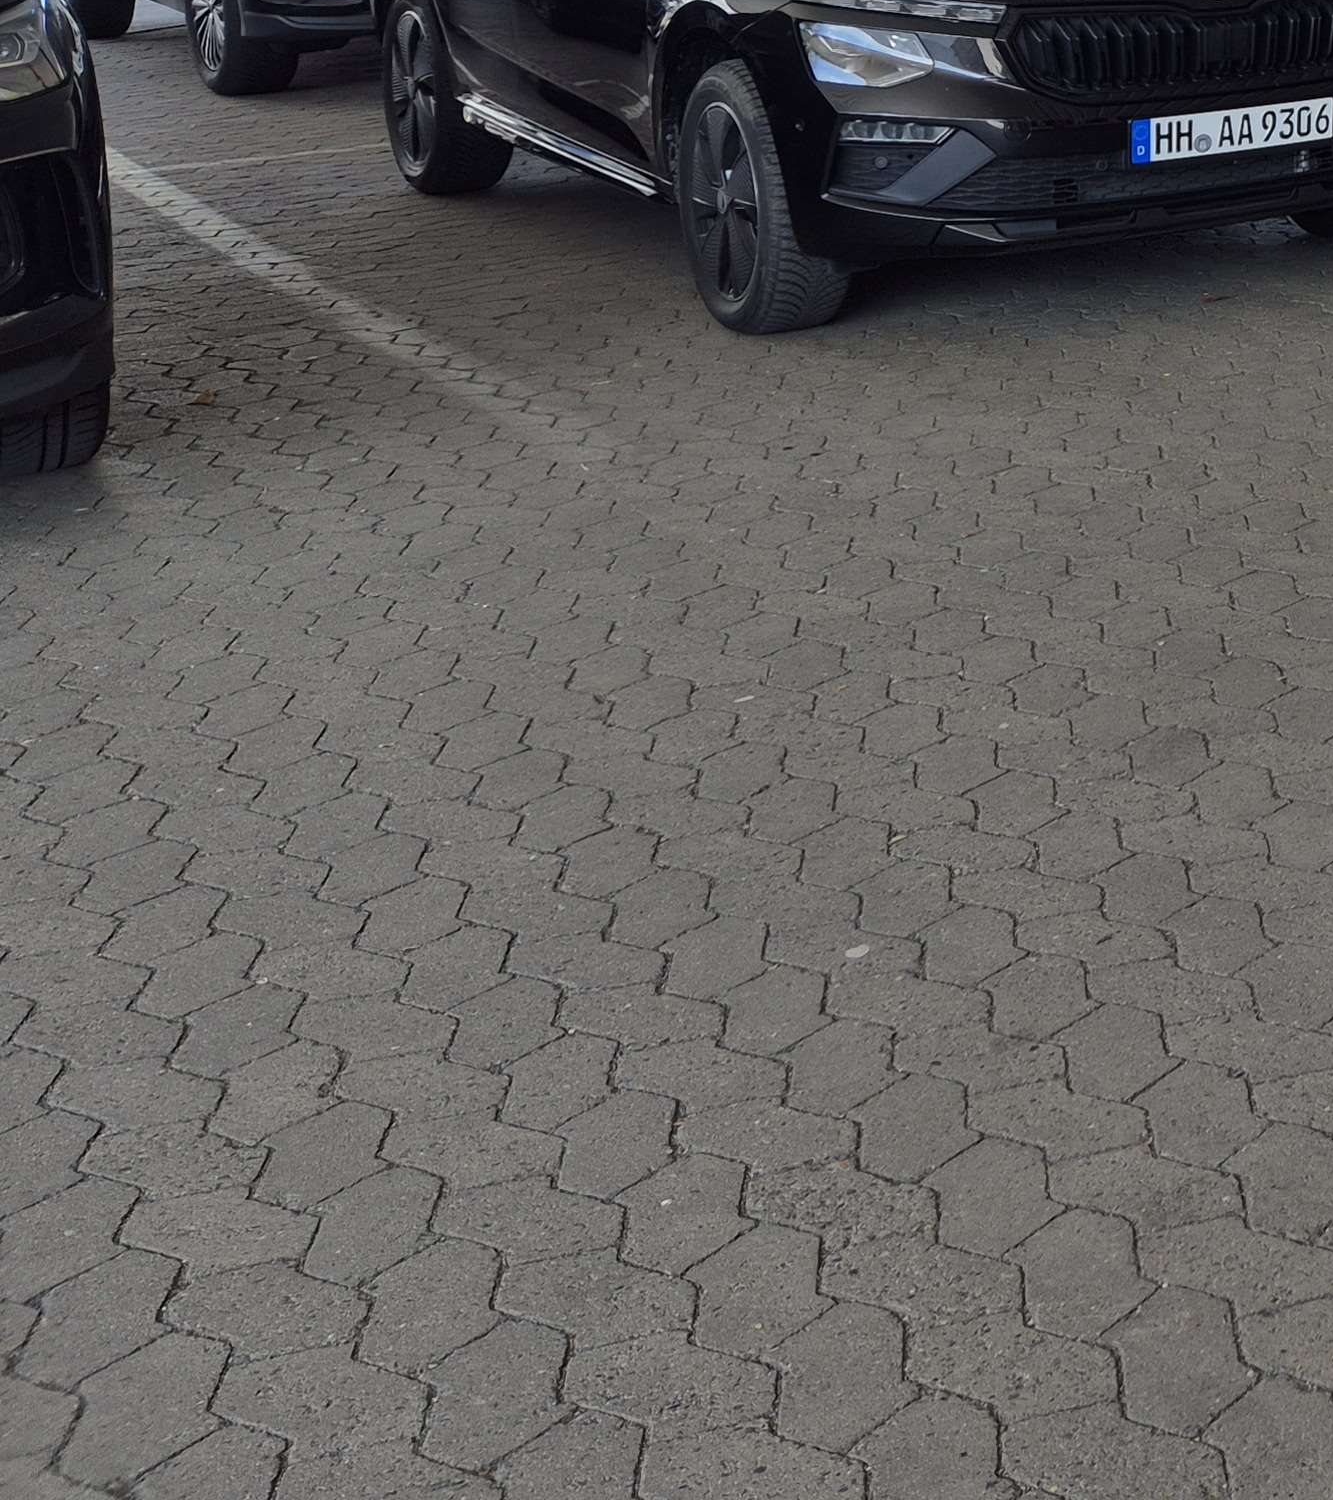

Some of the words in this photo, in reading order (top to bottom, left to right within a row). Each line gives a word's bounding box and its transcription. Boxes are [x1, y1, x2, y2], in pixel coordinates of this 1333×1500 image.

[1155, 119, 1193, 156] HH
[1218, 113, 1254, 148] AA
[1261, 103, 1331, 143] 9306
[1136, 145, 1145, 156] D
